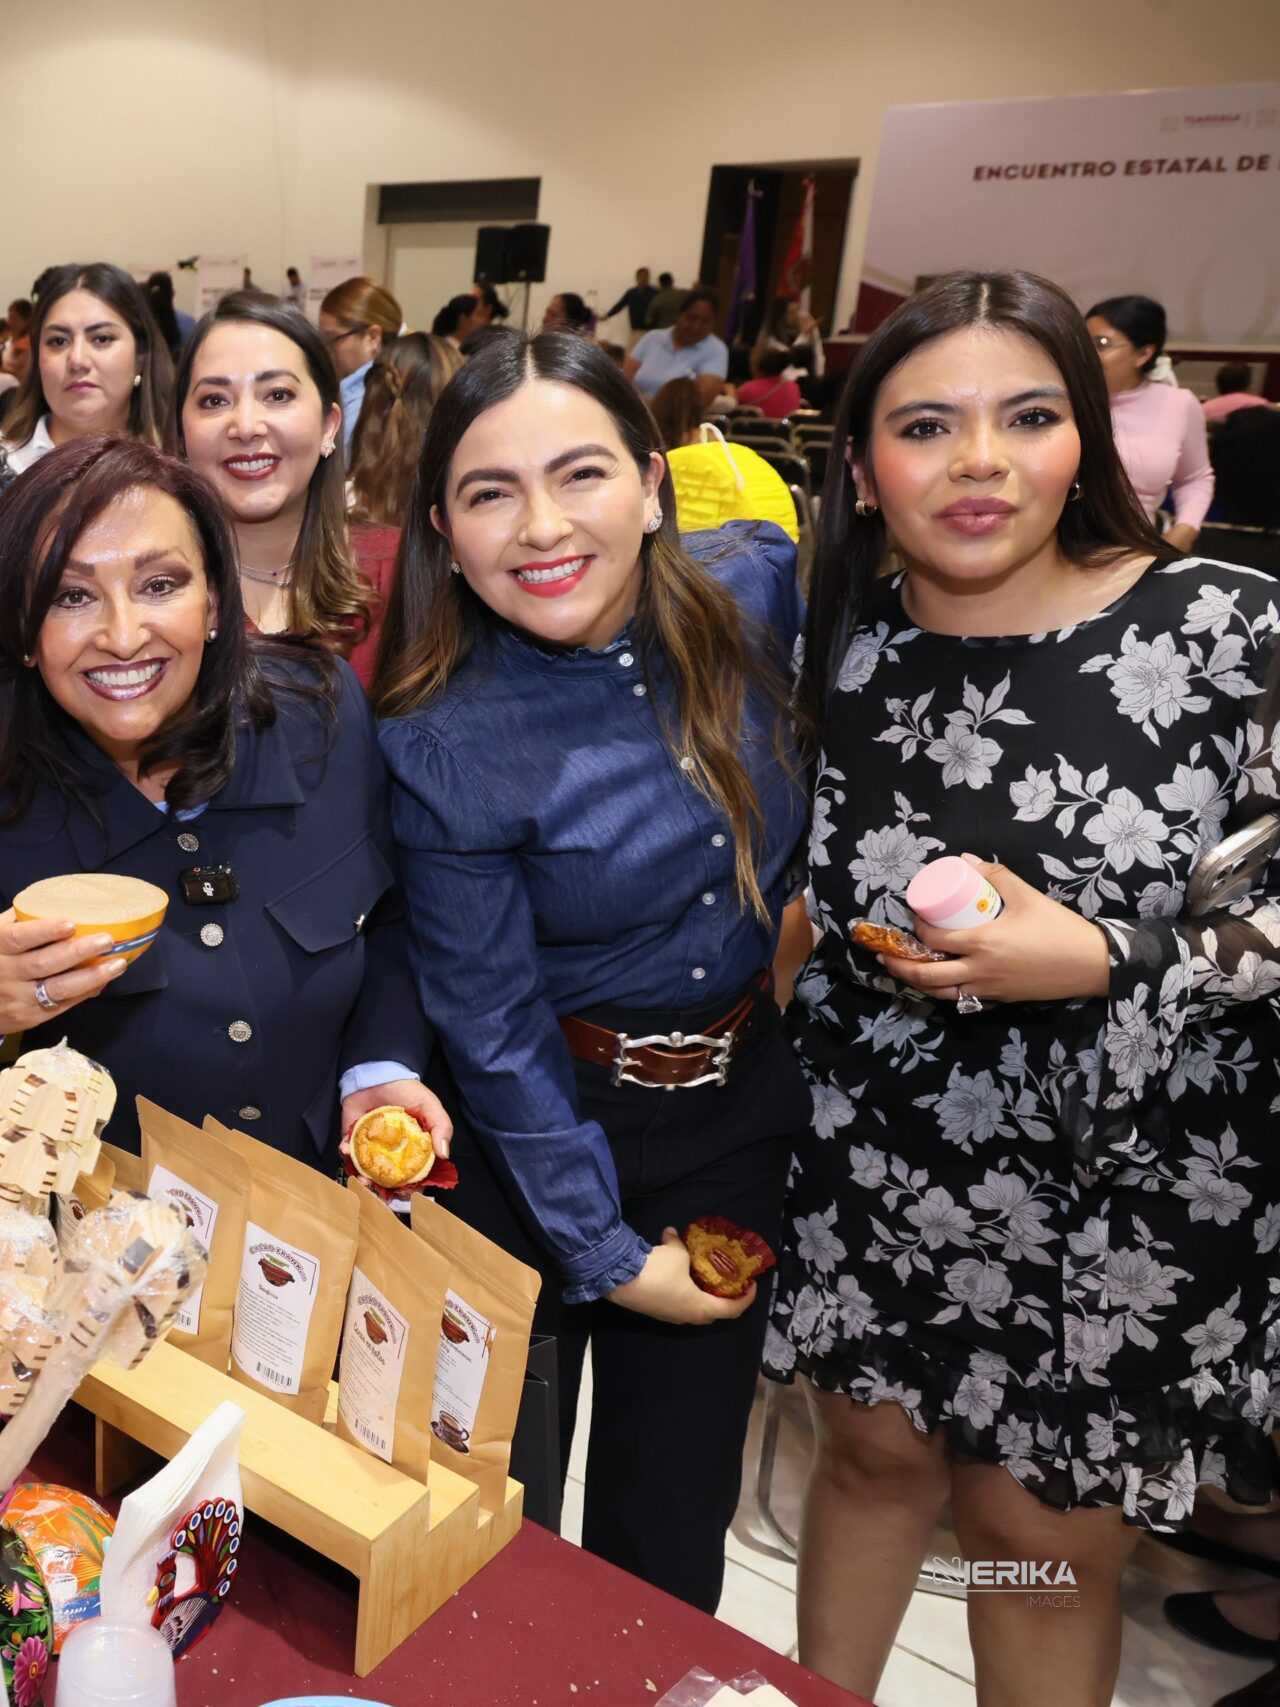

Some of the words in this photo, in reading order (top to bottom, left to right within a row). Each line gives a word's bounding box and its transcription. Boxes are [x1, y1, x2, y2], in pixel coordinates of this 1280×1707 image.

[972, 161, 1116, 182] ENCUENTRO
[1124, 157, 1227, 177] ESTATAL
[1236, 154, 1270, 172] DE
